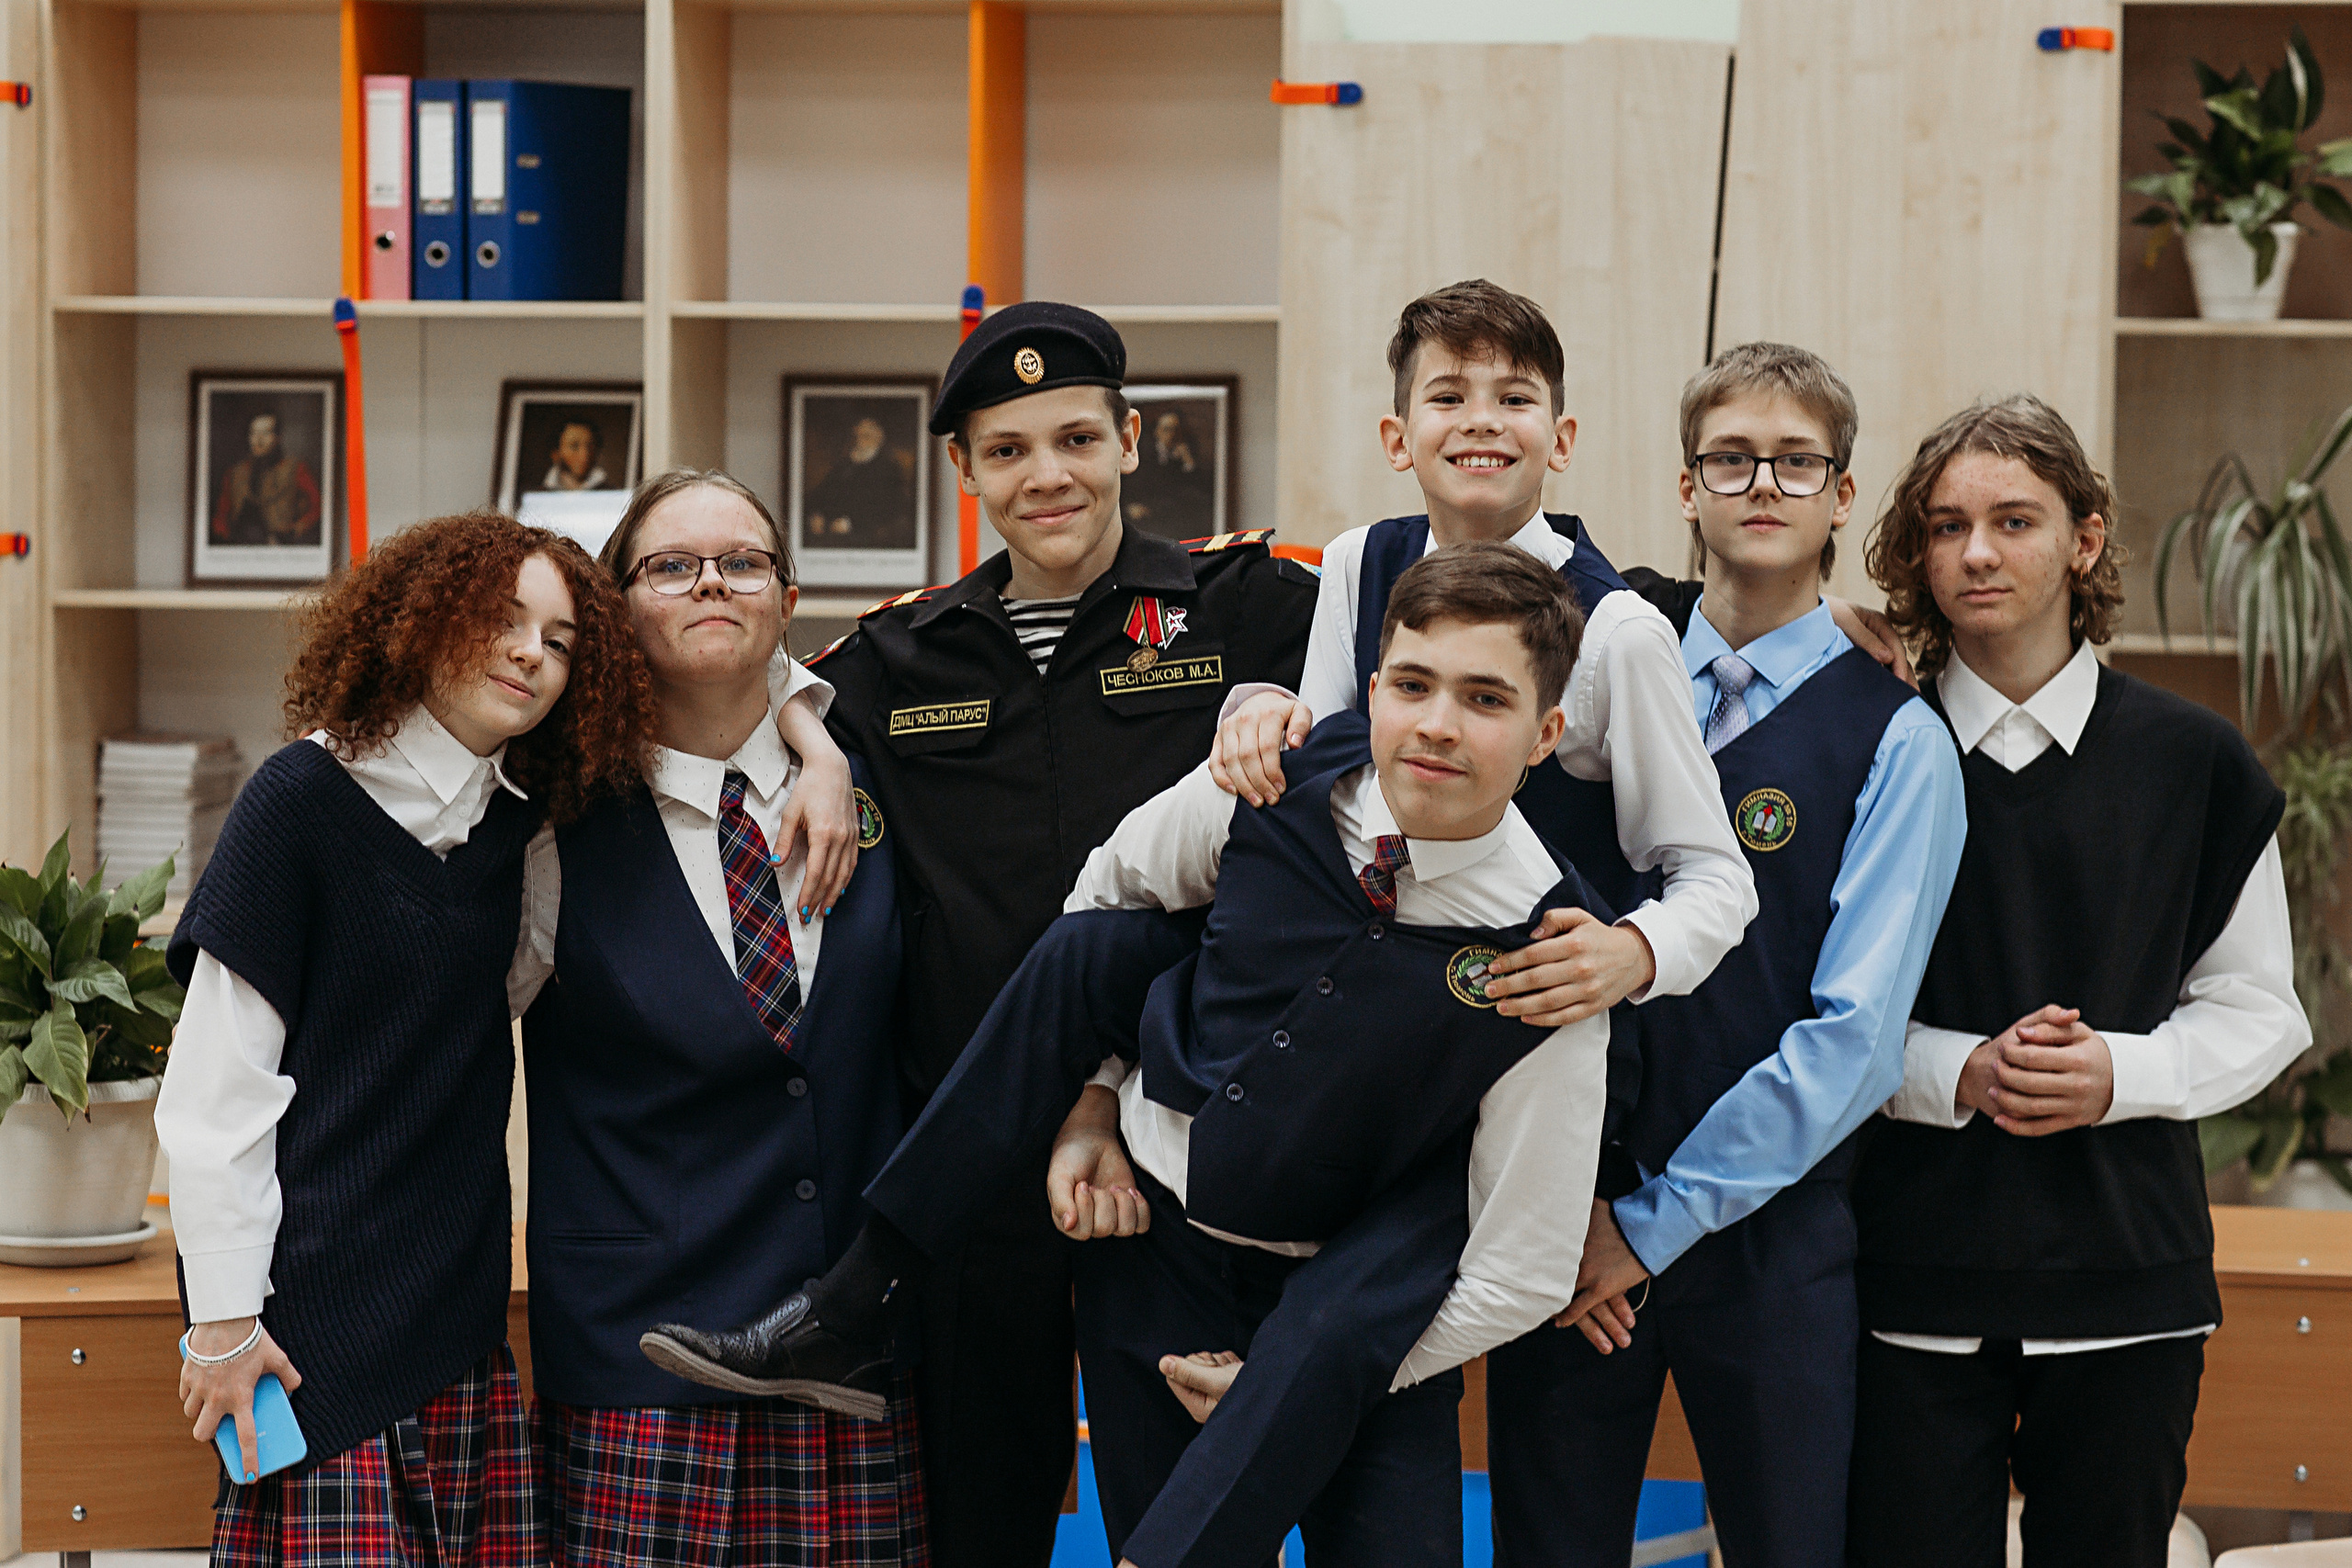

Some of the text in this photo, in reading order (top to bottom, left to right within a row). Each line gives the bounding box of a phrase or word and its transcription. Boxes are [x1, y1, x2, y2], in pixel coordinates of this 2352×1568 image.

[1107, 662, 1217, 687] ЧЕСНОКОВ М.А.
[892, 706, 987, 730] ДМЦ "АЛЫЙ ПАРУС"
[1742, 792, 1786, 813] ГИМНАЗИЯ
